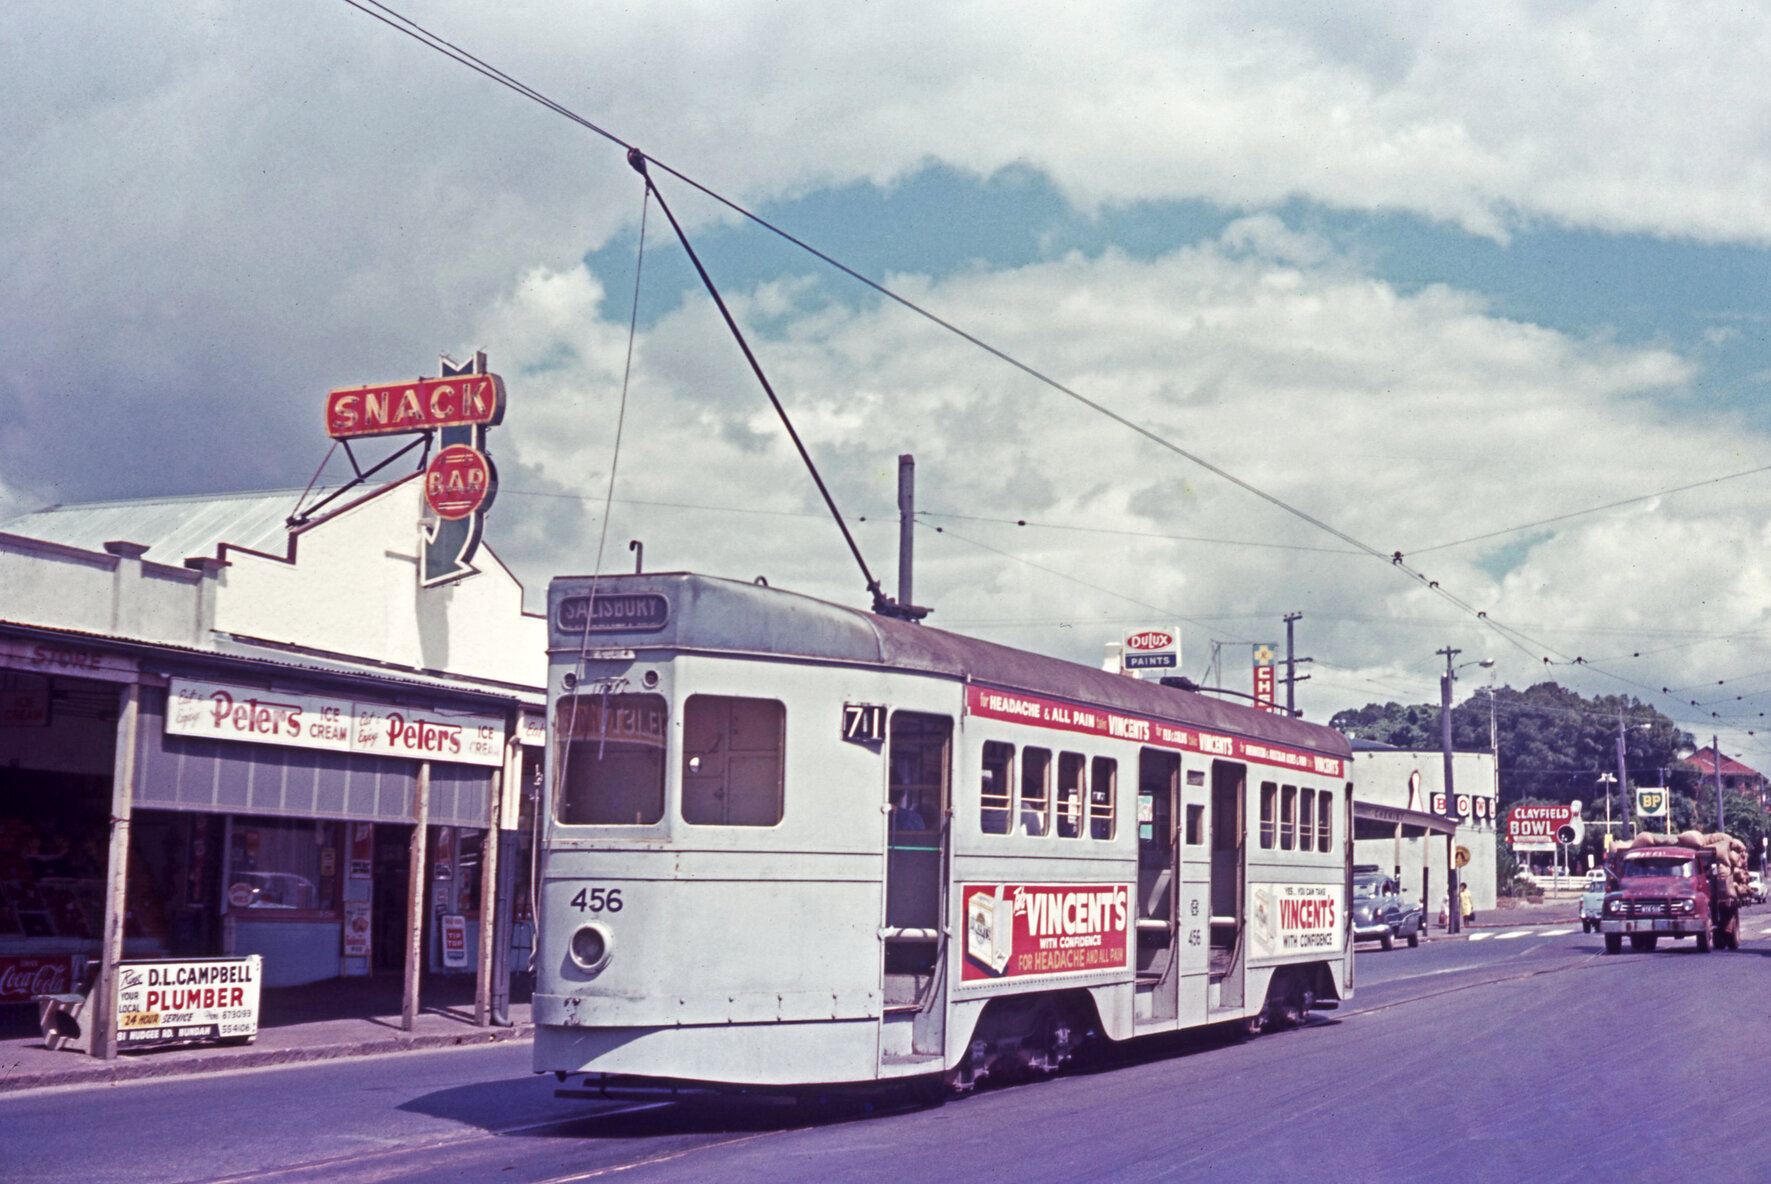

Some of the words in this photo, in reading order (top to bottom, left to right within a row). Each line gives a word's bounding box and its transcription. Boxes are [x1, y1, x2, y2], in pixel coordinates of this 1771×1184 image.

[333, 381, 488, 429] SNACK
[429, 469, 485, 497] BAR
[566, 598, 657, 619] SALISBURY
[31, 645, 101, 672] STORE
[1131, 656, 1171, 666] PAINTS
[1257, 667, 1272, 713] CHE
[209, 690, 303, 738] Peters
[320, 706, 341, 723] ICE
[989, 695, 1040, 718] HEADACHE
[1044, 707, 1050, 721] &
[1051, 707, 1071, 724] ALL
[1073, 711, 1095, 728] PAIN
[309, 723, 348, 741] CREAM
[386, 711, 463, 755] Peters
[478, 724, 494, 741] ICE
[846, 707, 879, 738] 71
[1641, 794, 1661, 808] BP
[1514, 808, 1569, 819] CLAYFIELD
[1509, 820, 1555, 836] BOWL
[571, 888, 624, 913] 456
[1026, 886, 1127, 936] VINCENT'S
[1280, 894, 1335, 930] VINCENT'S
[1040, 937, 1057, 949] WITH
[1059, 935, 1101, 948] CONFIDENCE
[1188, 929, 1201, 946] 456
[1283, 935, 1298, 948] WITH
[1300, 933, 1333, 947] CONFIDENCE
[1018, 954, 1033, 971] FOR
[1034, 950, 1085, 970] HEADACHE
[1086, 951, 1098, 964] AND
[1099, 950, 1109, 963] ALL
[1110, 948, 1124, 961] PAIN
[121, 991, 139, 1001] YOUR
[146, 987, 244, 1012] PLUMBER
[119, 1003, 140, 1013] LOCAL
[124, 1015, 137, 1026] 24
[138, 1014, 159, 1025] HOUR
[161, 1013, 195, 1024] SERVICE
